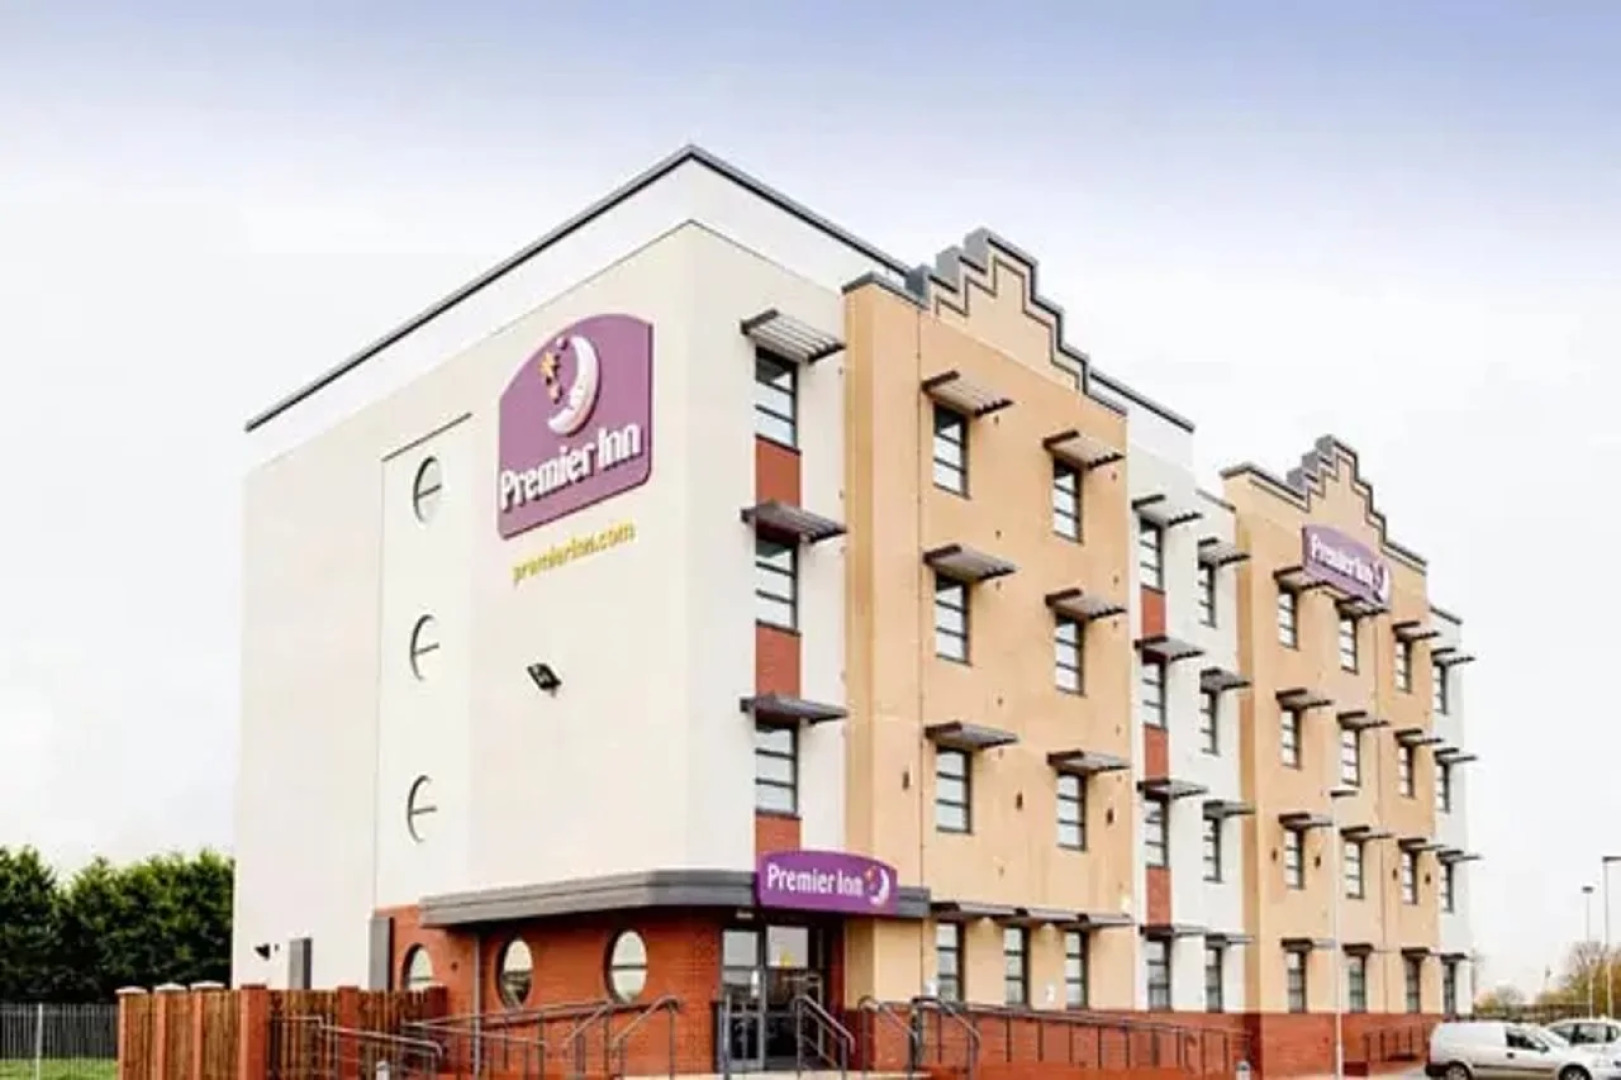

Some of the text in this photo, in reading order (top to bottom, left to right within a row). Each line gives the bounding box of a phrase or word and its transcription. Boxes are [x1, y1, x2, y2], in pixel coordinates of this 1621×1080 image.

[501, 423, 642, 511] Premier Inn
[512, 522, 635, 585] premierinn.com
[767, 862, 864, 897] Premier Inn
